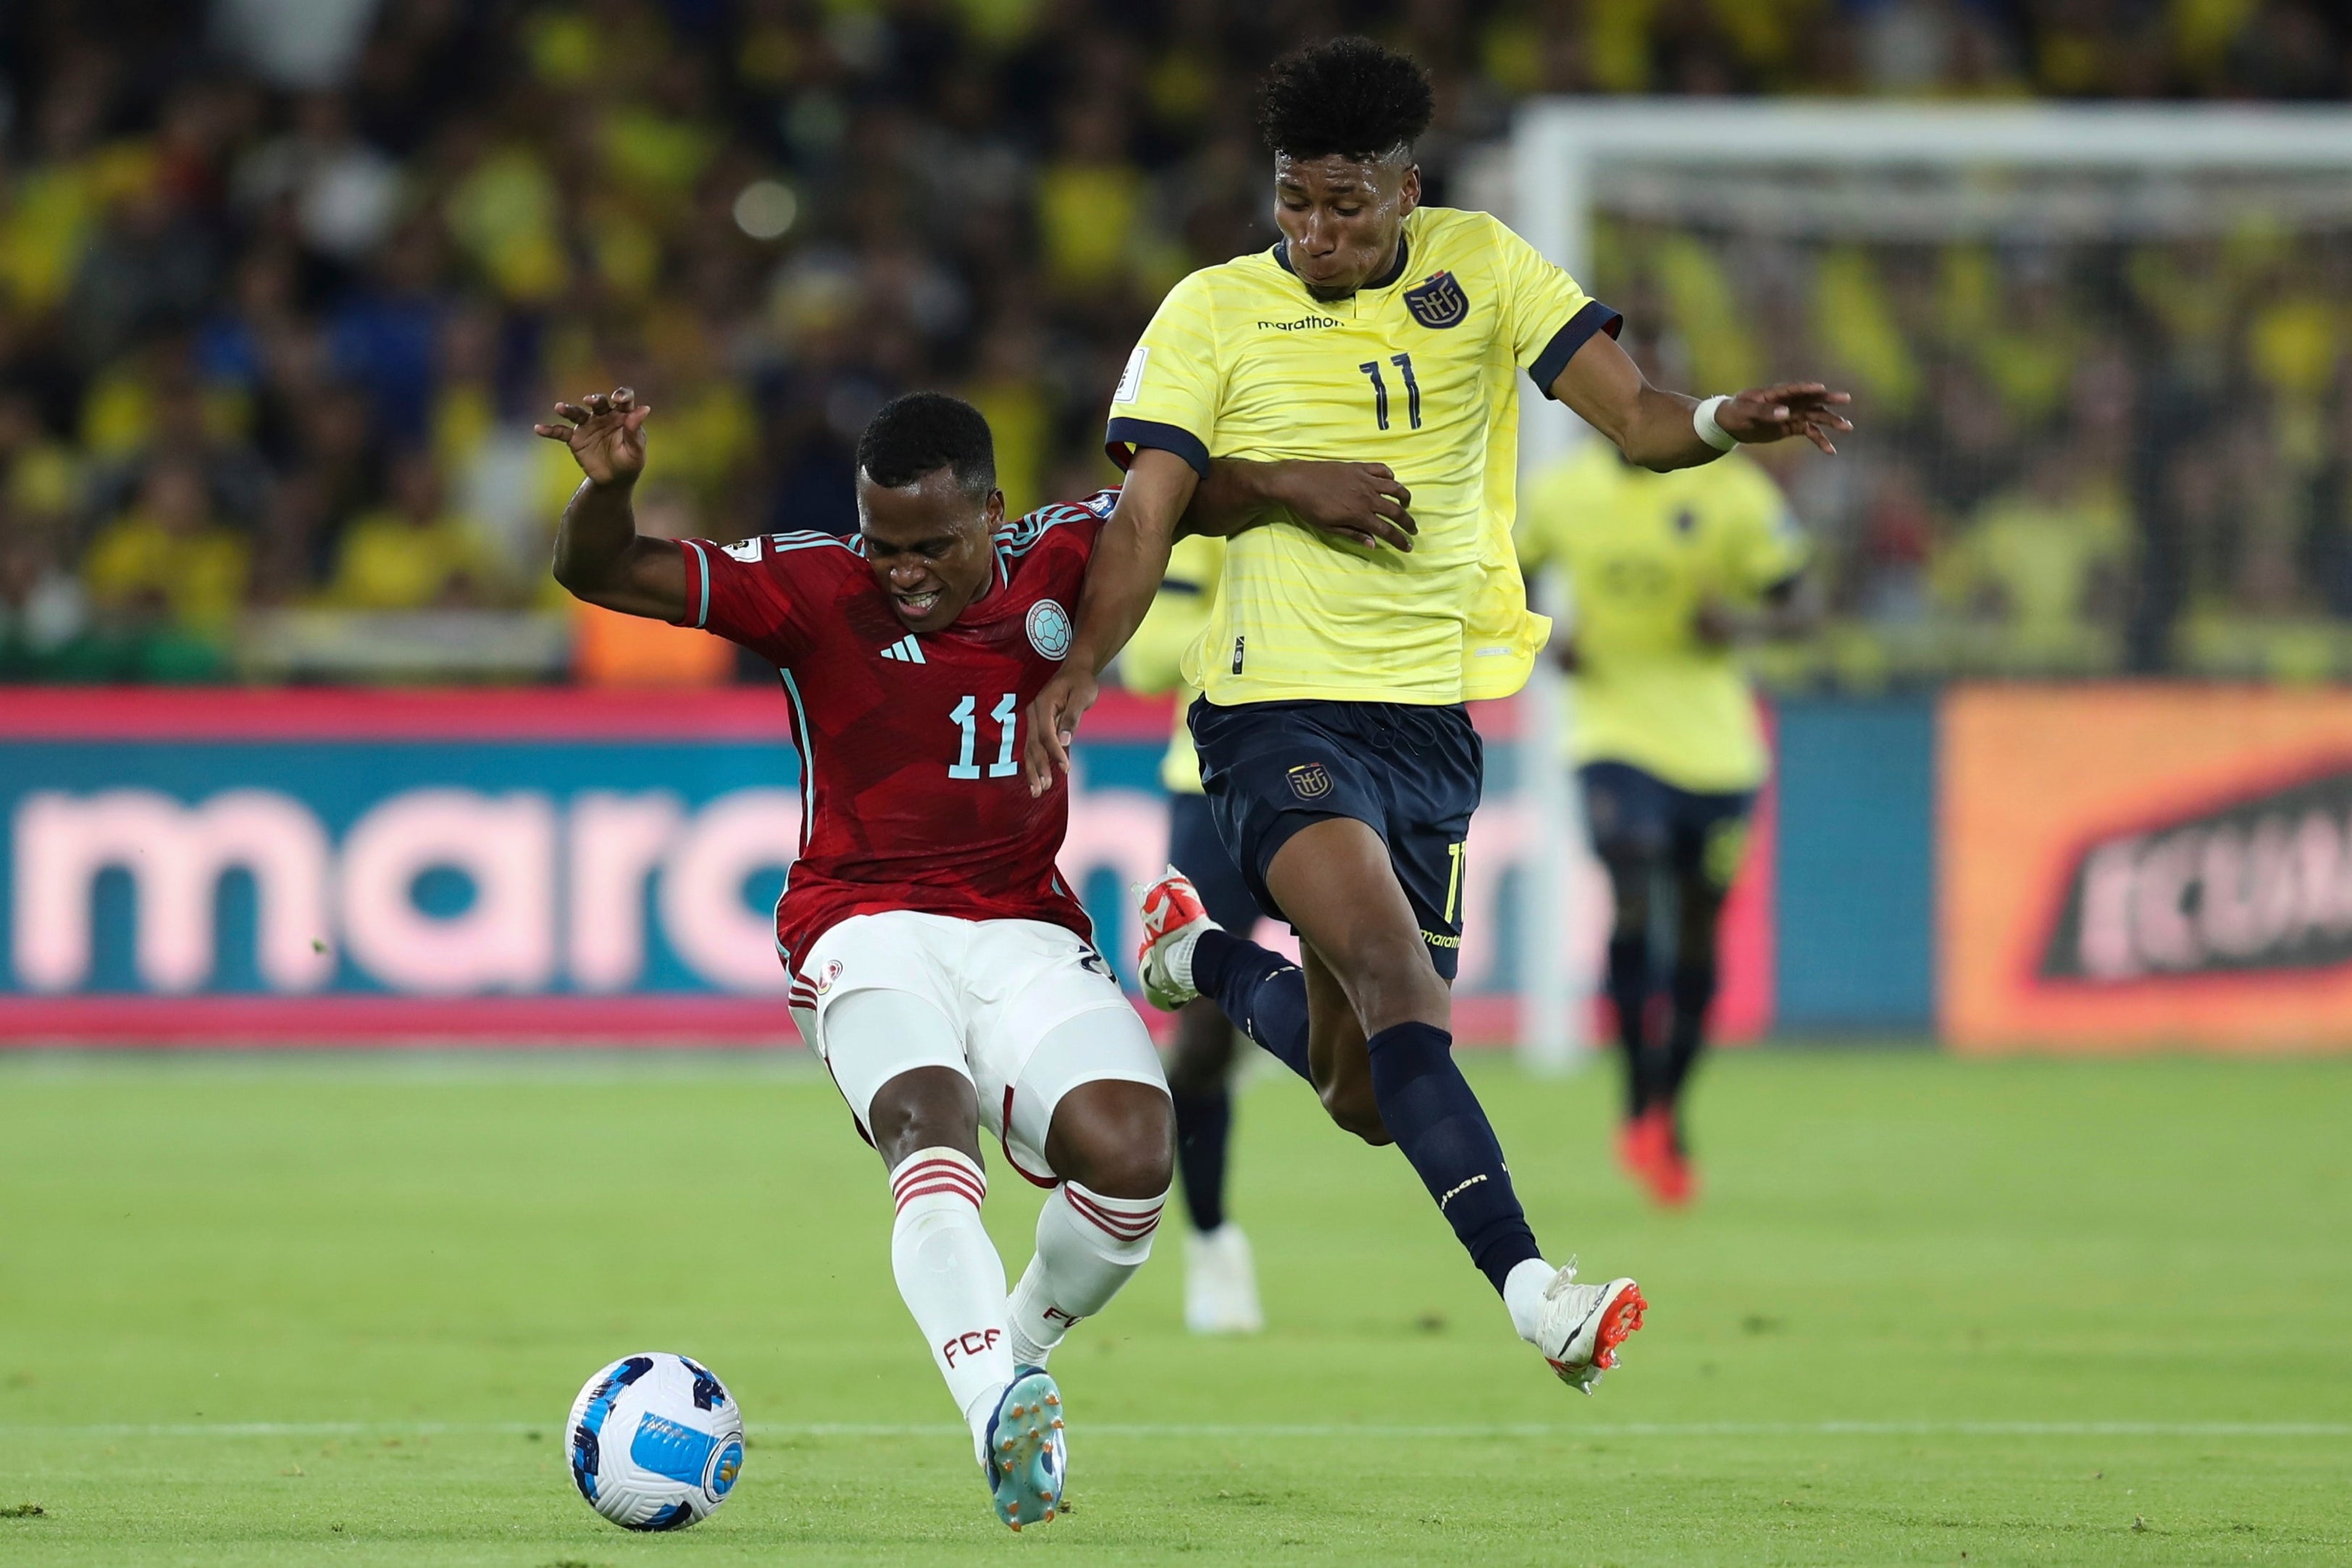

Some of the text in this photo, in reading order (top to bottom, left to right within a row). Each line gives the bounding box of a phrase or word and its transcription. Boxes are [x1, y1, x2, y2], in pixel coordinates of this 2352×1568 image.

[1257, 315, 1345, 331] marathon
[1359, 352, 1422, 431] 11
[948, 693, 1018, 779] 11
[2076, 805, 2352, 984] ECUA
[1042, 1307, 1084, 1328] FC
[943, 1329, 1000, 1370] FCF
